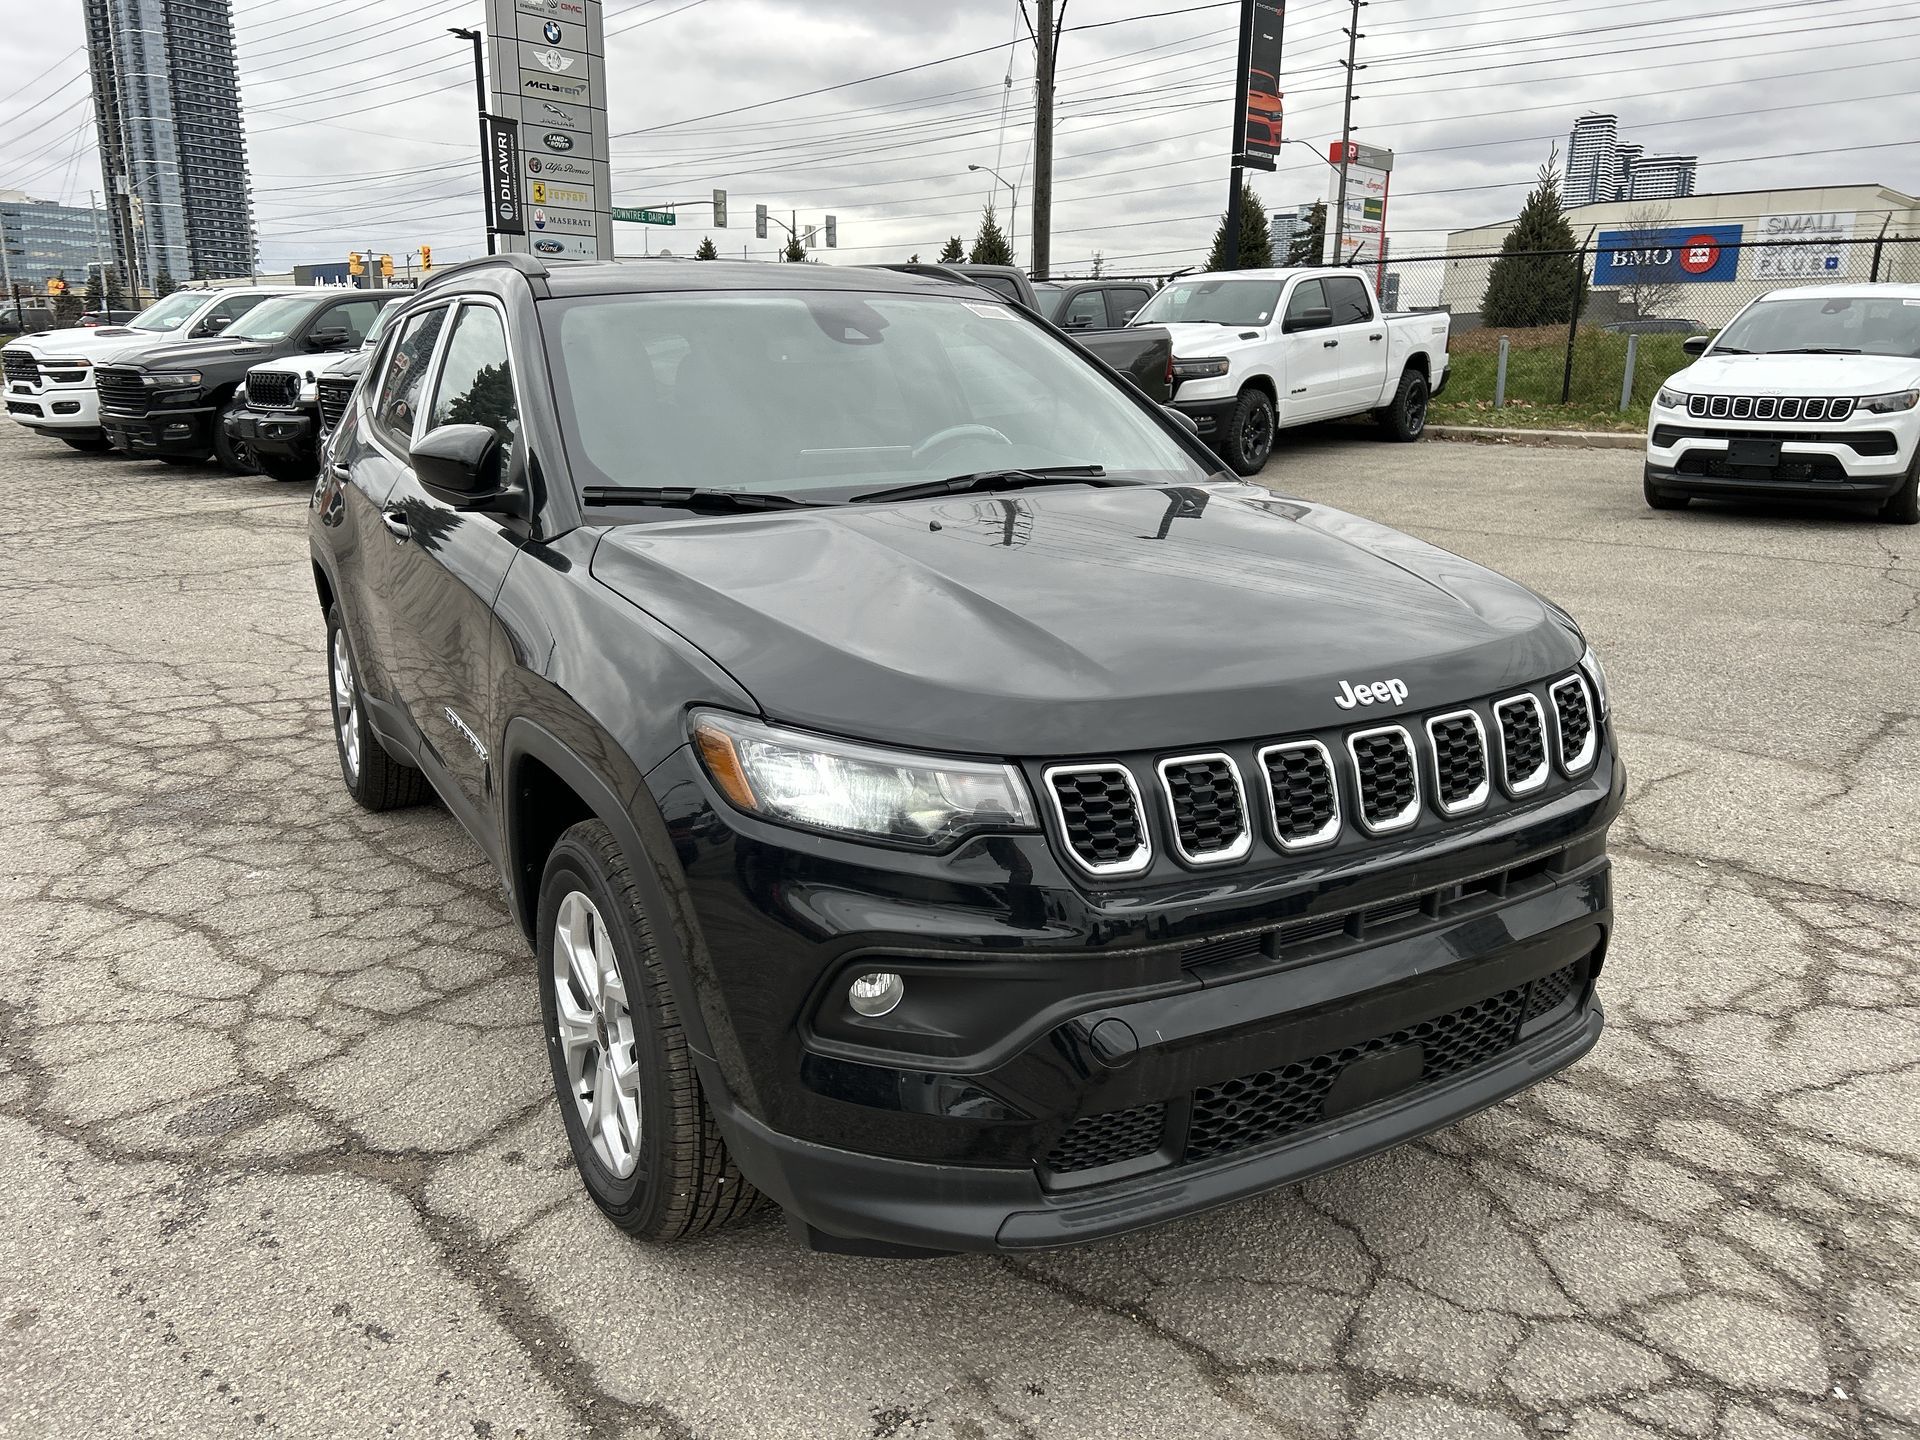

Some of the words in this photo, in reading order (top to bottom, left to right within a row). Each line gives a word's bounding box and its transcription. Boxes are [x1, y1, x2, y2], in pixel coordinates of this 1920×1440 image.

[560, 3, 582, 14] GMC
[540, 119, 575, 128] JAGUAR
[550, 141, 569, 149] ROVER
[497, 131, 511, 200] DILAWRI
[545, 162, 563, 174] Alfa
[564, 163, 591, 175] Romeo
[549, 216, 591, 227] MASERATI
[612, 208, 646, 221] ROWNTREE
[648, 212, 666, 223] DAIRY
[1767, 213, 1843, 235] SMALL
[540, 242, 558, 252] Ford
[1610, 248, 1673, 267] BMO
[1334, 678, 1409, 710] Jeep
